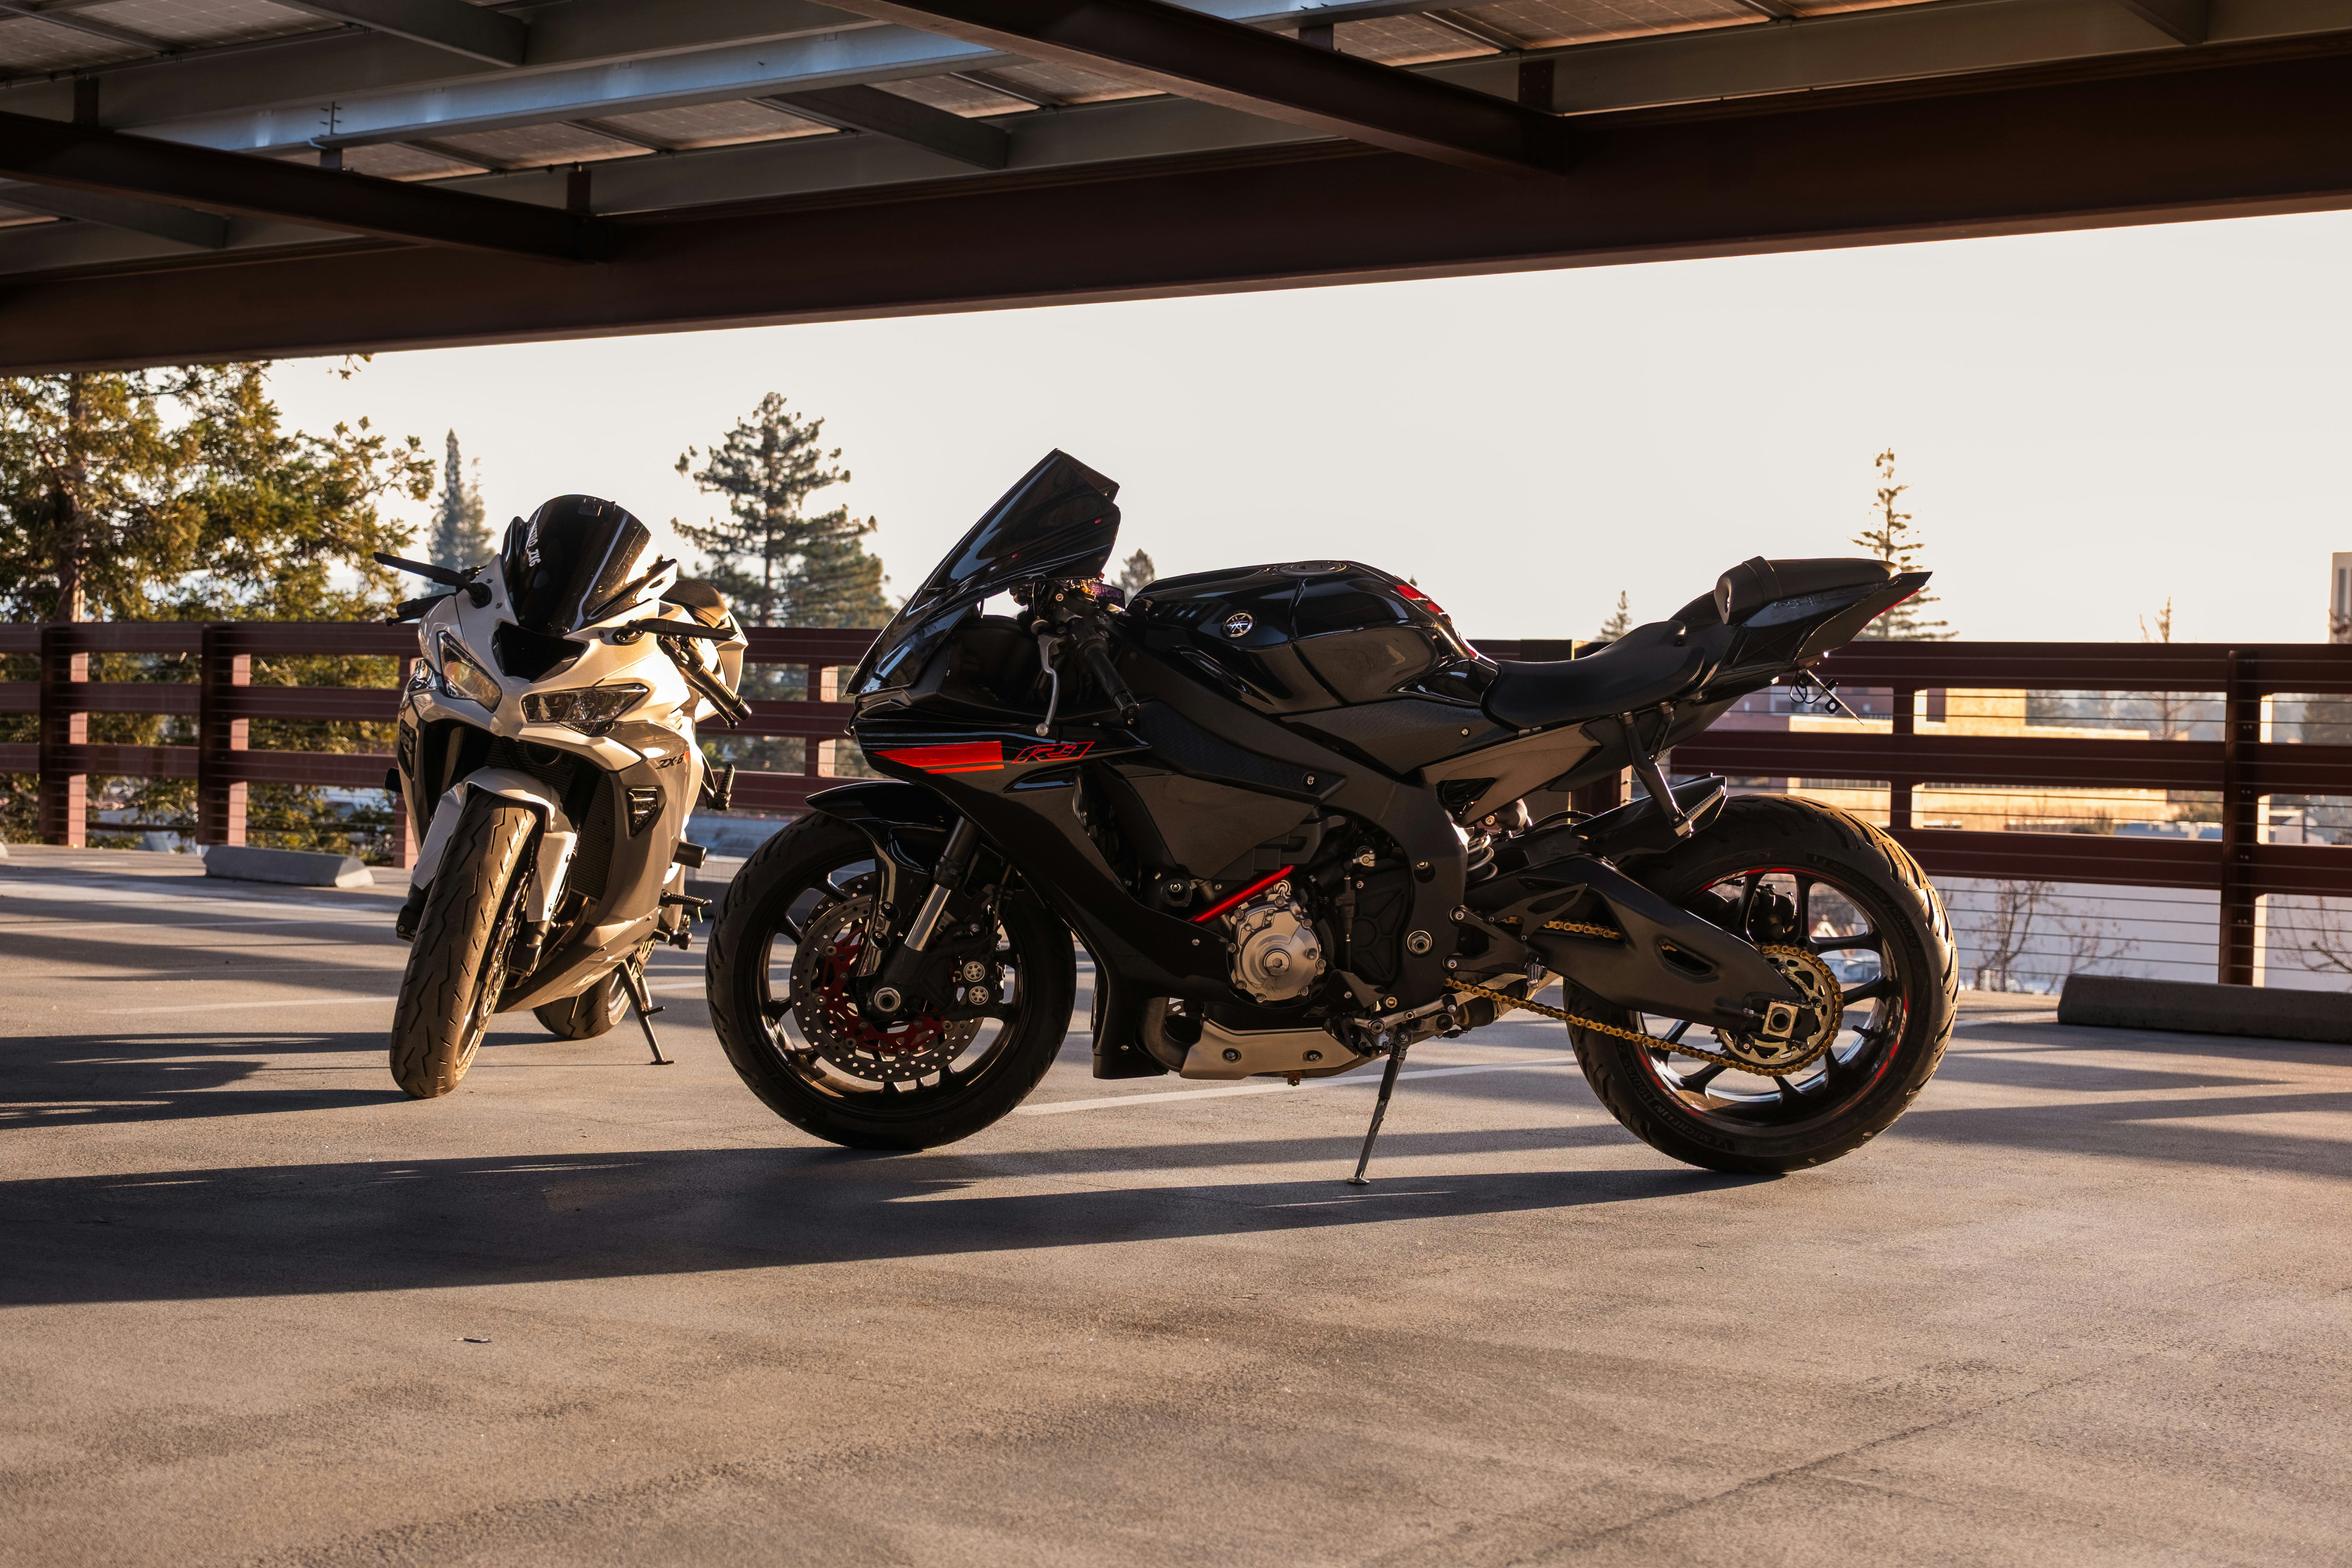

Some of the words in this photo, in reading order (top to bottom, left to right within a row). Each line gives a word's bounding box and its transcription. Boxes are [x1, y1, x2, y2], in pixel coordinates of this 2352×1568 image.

[1011, 741, 1095, 764] R1
[1830, 862, 1888, 900] MICHELIN
[1891, 908, 1914, 936] ROAD
[1623, 1058, 1651, 1099] 190/55
